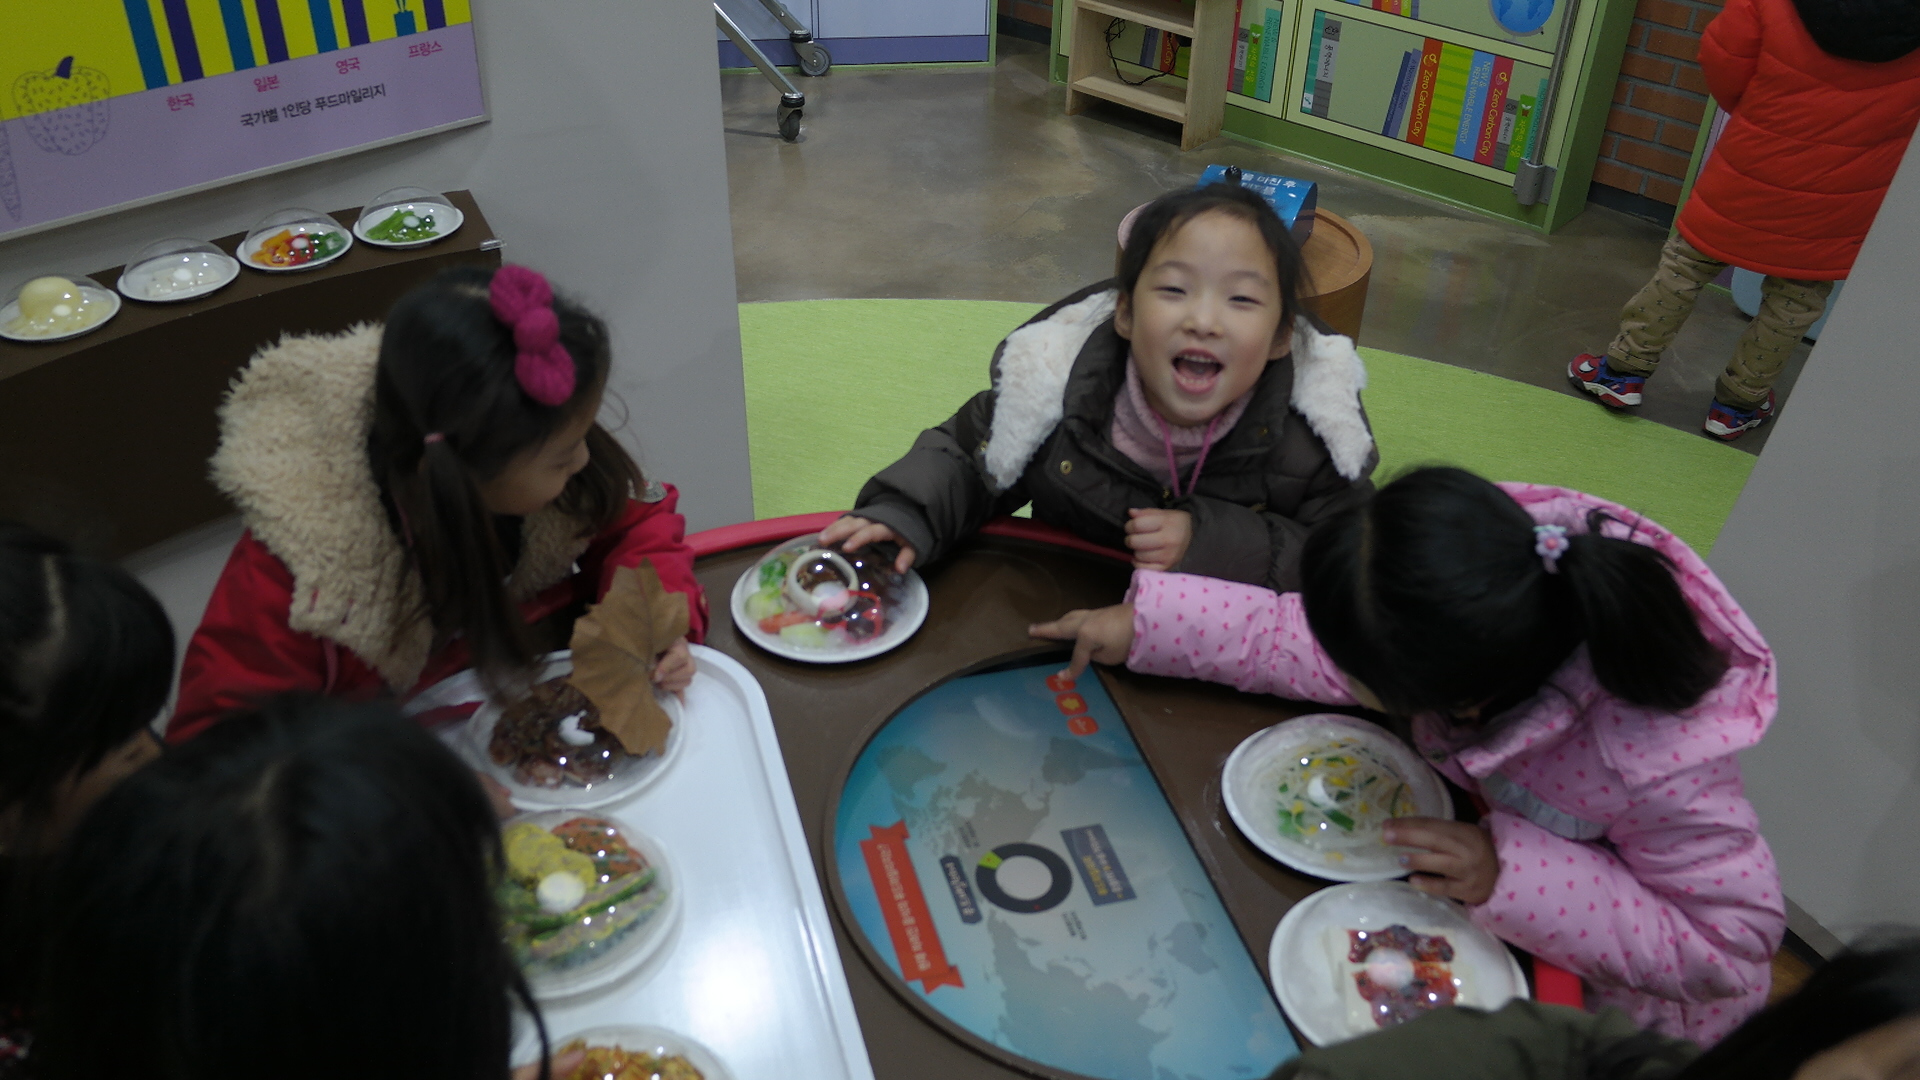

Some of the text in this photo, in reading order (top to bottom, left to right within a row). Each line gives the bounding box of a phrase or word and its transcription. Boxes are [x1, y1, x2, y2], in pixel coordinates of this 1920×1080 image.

[408, 41, 443, 59] 프랑스
[335, 57, 360, 75] 영국
[1481, 60, 1492, 81] NEW
[253, 75, 280, 93] 일본
[166, 93, 195, 112] 한국
[240, 83, 386, 128] 국가별 1인당 푸드마일리지
[1411, 69, 1433, 138] Zero Carbon City
[1459, 113, 1472, 145] ENERGY
[1479, 88, 1503, 157] Zero Carbon City
